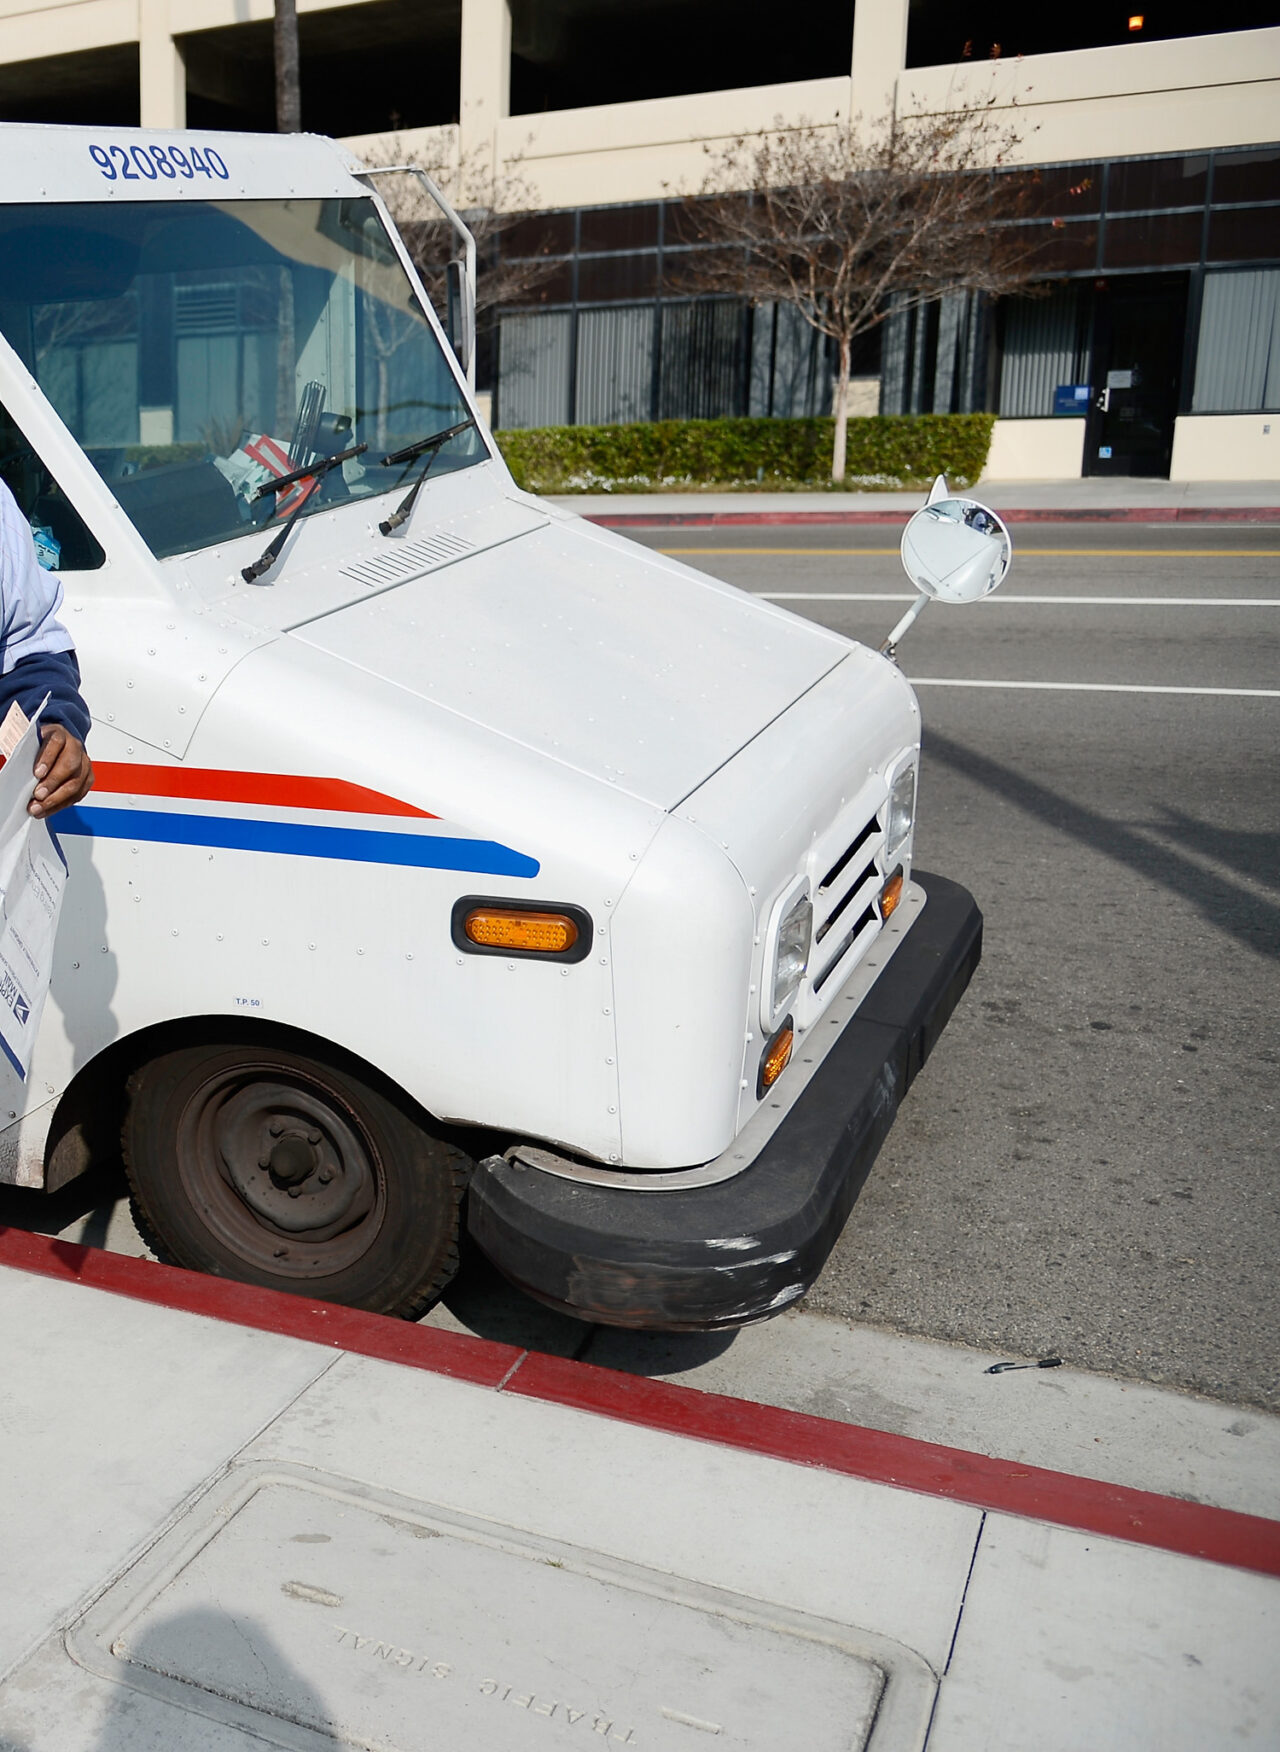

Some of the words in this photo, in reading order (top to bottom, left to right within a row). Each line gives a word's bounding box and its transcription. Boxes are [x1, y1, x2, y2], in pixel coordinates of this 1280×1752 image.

[89, 144, 229, 180] 9208940
[4, 970, 18, 997] MAIL
[334, 1624, 453, 1679] SIGNAL
[479, 1678, 637, 1745] TRAFFIC
